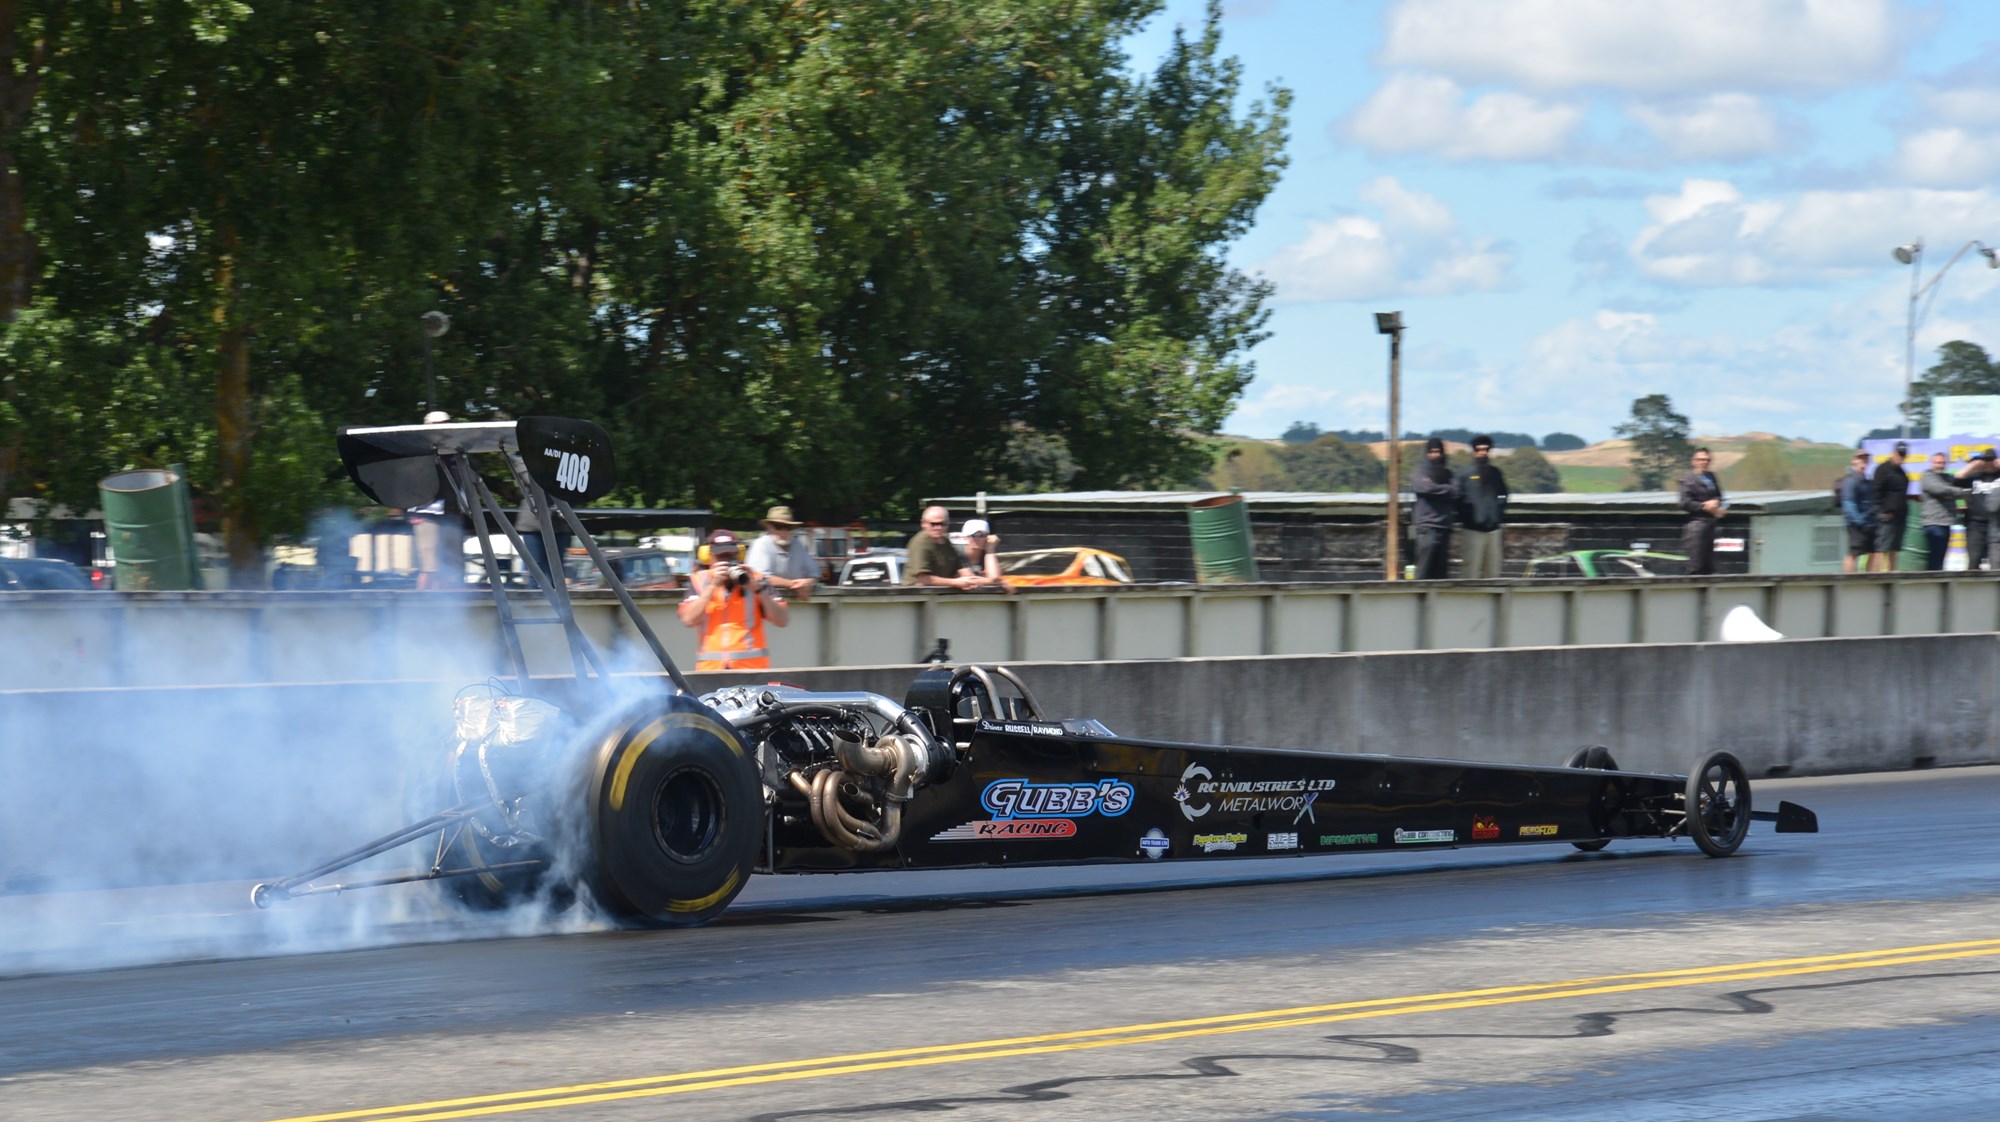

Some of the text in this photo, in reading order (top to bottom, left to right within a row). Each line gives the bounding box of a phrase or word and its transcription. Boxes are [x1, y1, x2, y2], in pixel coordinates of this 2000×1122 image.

[556, 452, 591, 493] 408
[983, 780, 1132, 818] GUBB'S
[1197, 779, 1336, 793] RC INDUSTRIES LTD
[1218, 792, 1319, 826] METALWORX
[978, 823, 1068, 835] RACING
